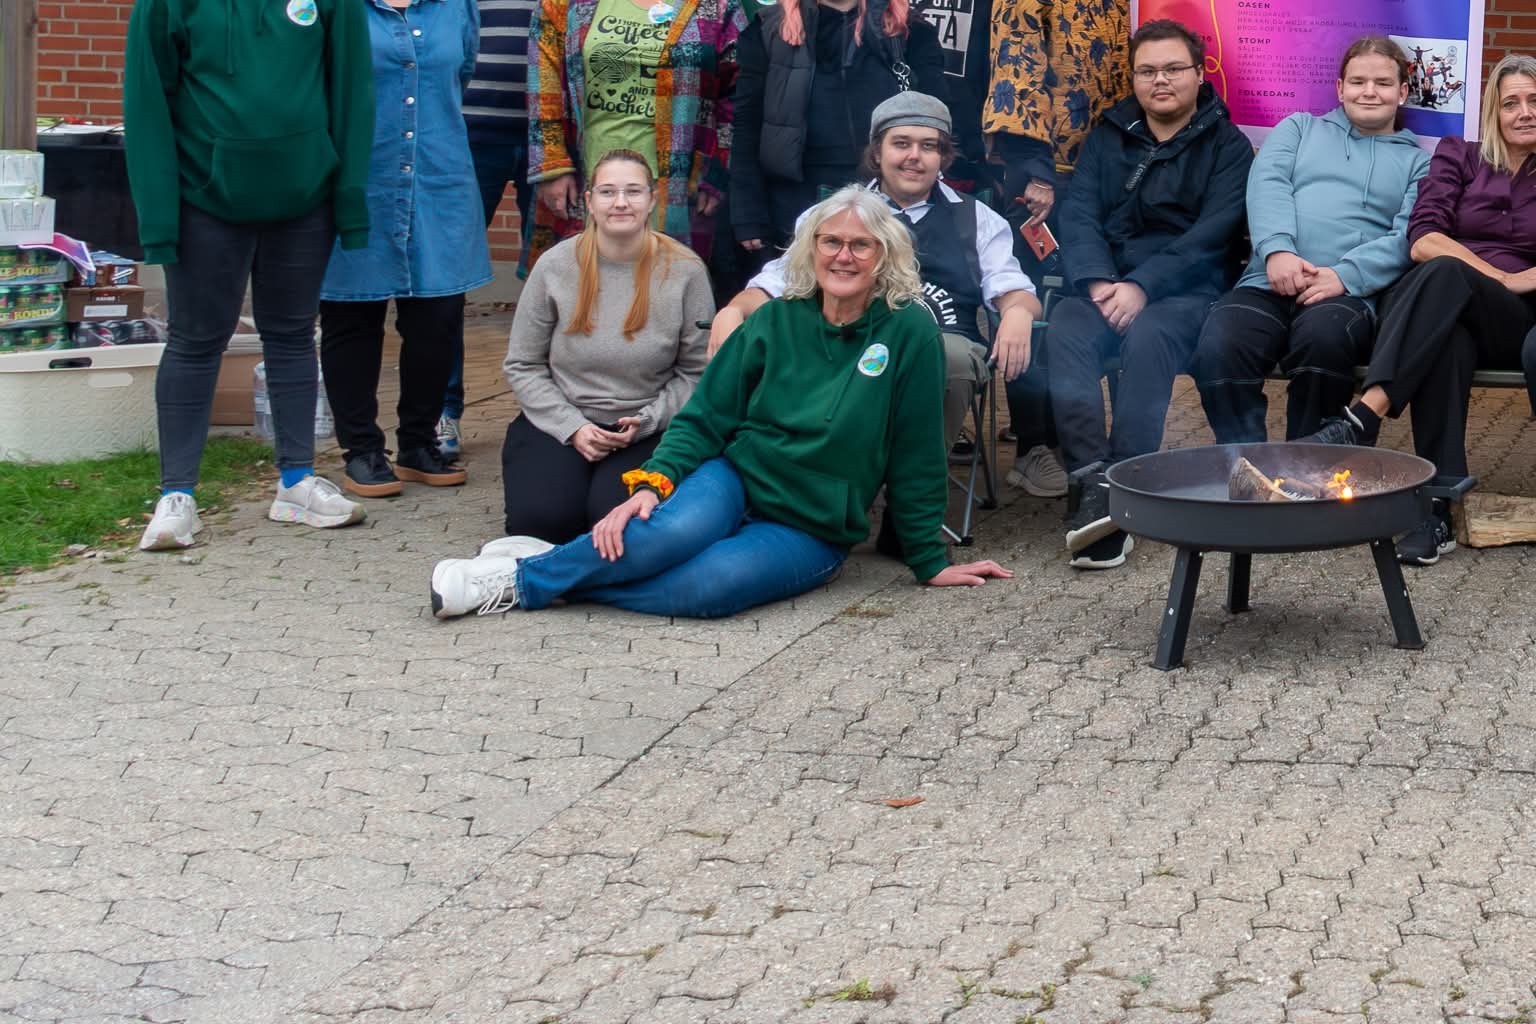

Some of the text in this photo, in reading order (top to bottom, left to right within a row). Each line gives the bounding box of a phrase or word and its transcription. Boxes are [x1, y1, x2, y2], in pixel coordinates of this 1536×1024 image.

[1238, 1, 1271, 9] OASEN
[1238, 37, 1271, 45] STOMP
[628, 86, 648, 95] AND
[1237, 89, 1296, 98] FOLKEDANS
[587, 90, 656, 118] Crochet
[920, 282, 957, 325] HELIN
